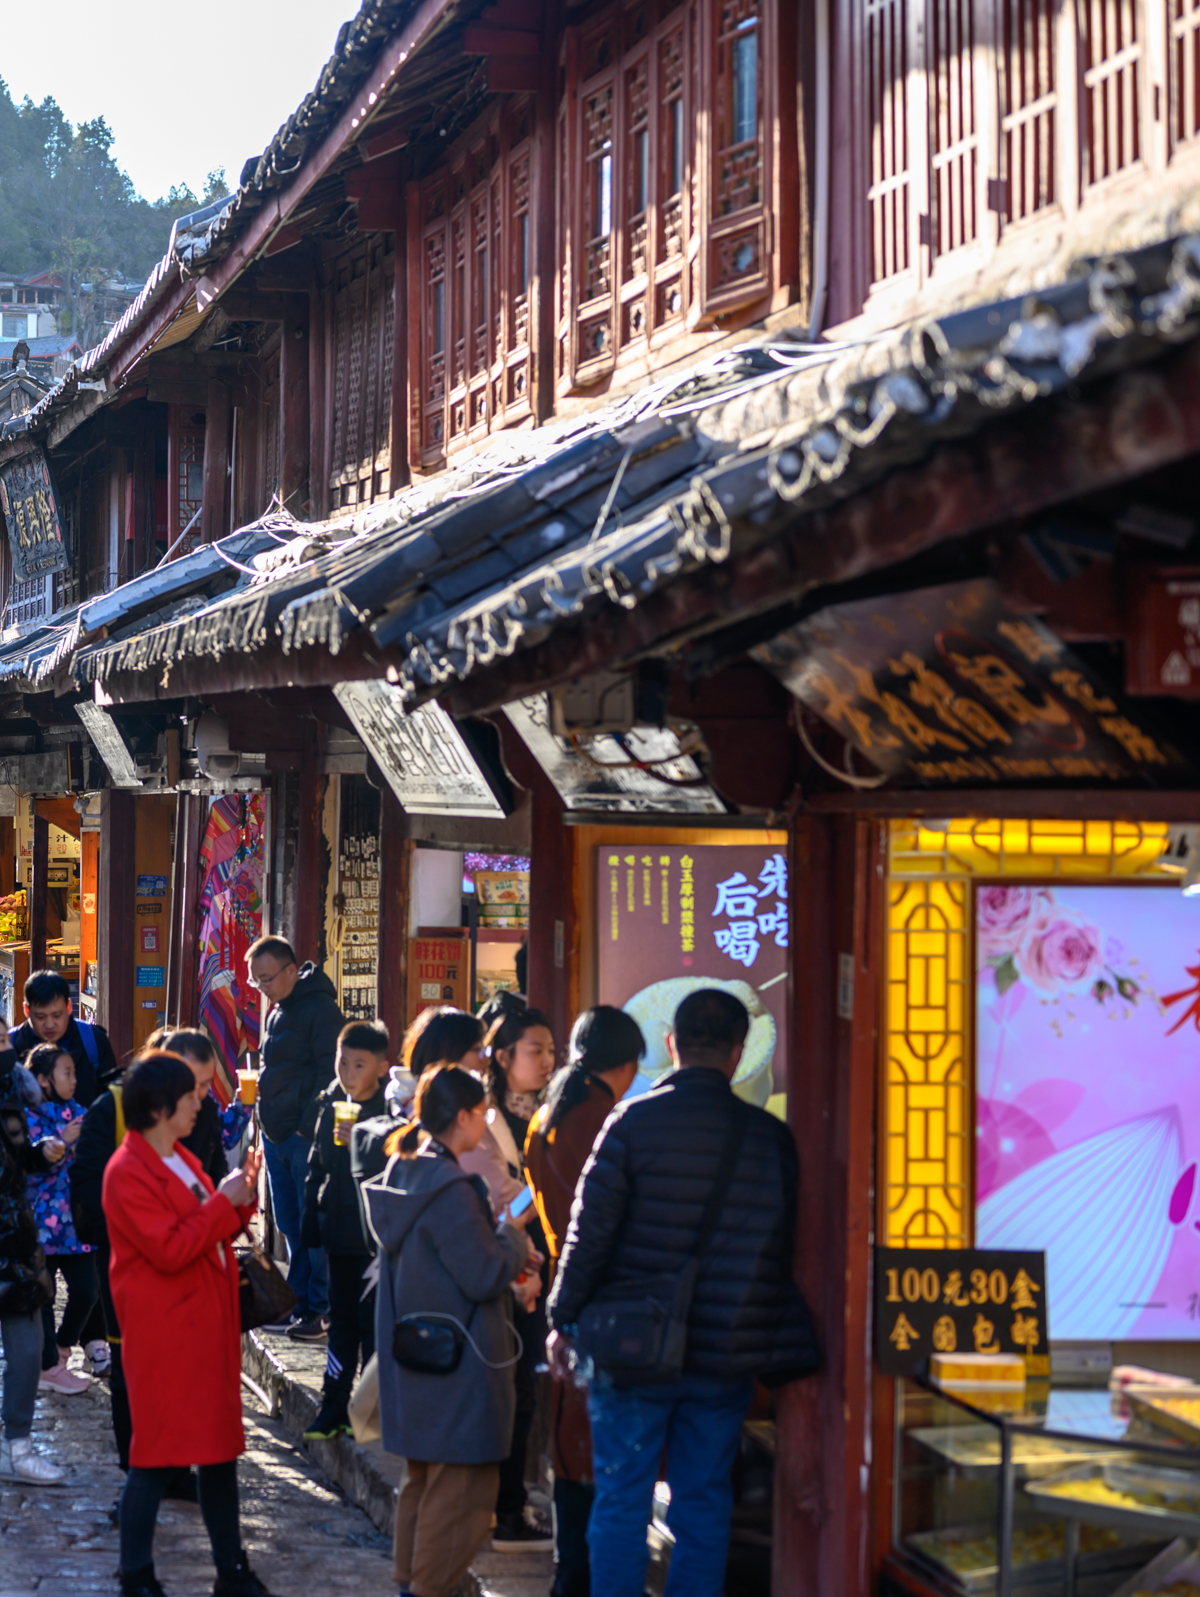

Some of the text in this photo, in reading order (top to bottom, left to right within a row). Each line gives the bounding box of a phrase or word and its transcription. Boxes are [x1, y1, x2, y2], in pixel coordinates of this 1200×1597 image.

[711, 871, 760, 967] 后喝
[415, 941, 460, 960] 鲜花饼
[418, 964, 458, 980] 100元
[885, 1267, 1041, 1311] 100元30盒
[889, 1311, 1040, 1356] 全国包邮
